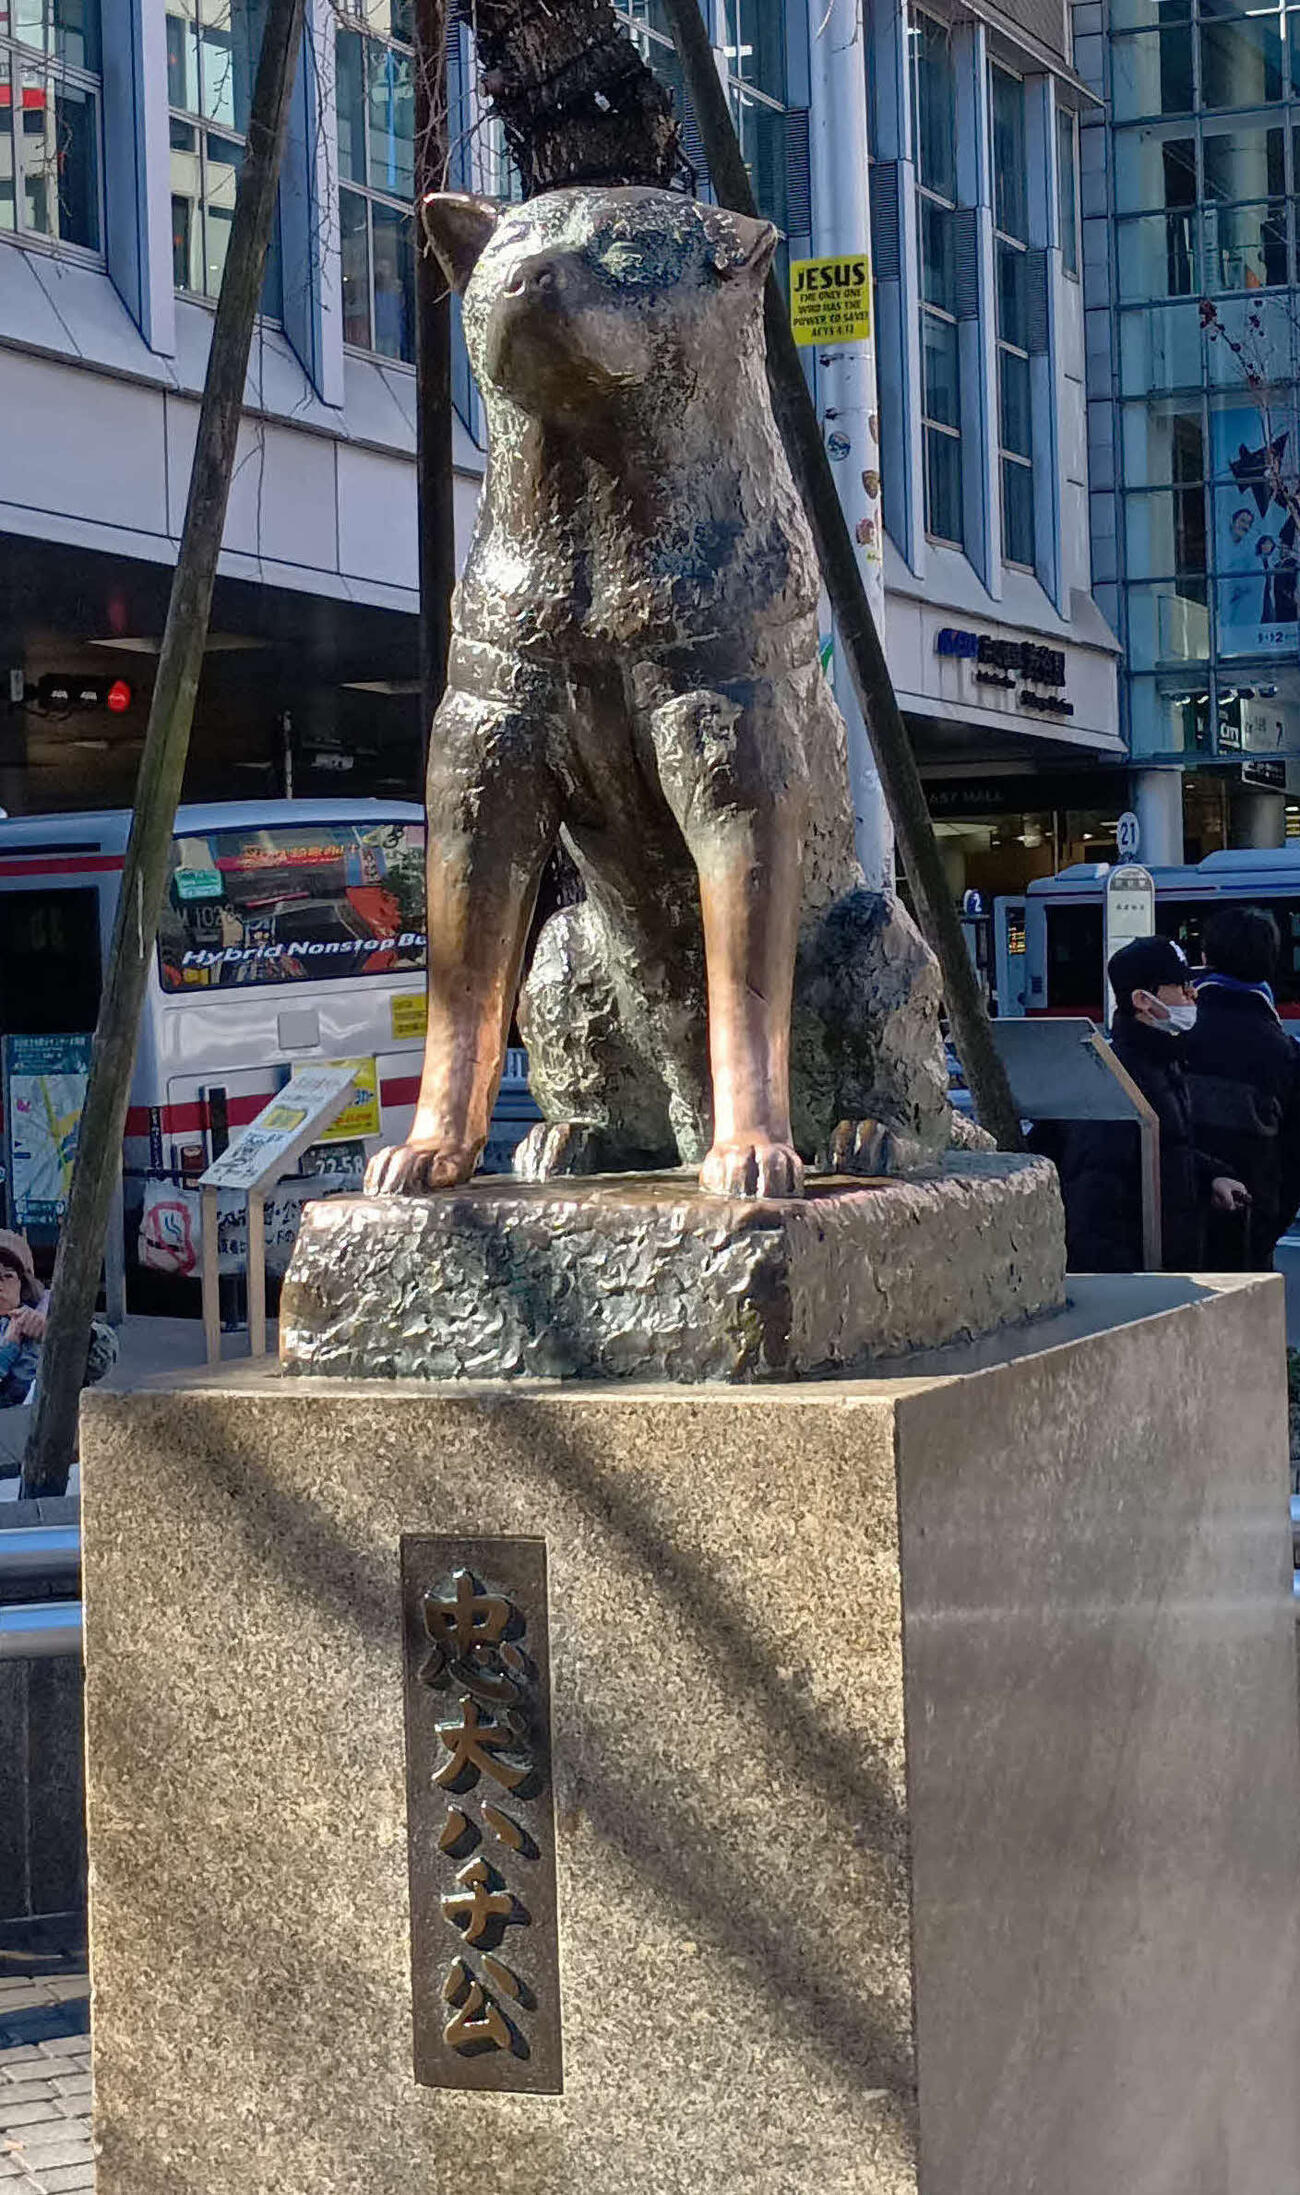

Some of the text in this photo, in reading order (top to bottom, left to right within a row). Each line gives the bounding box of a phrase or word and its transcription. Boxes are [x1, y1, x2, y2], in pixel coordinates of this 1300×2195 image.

[794, 262, 865, 292] JESUS
[1120, 823, 1136, 846] 21
[973, 892, 983, 912] 2
[181, 942, 281, 966] Hybrid
[286, 937, 396, 957] Nonstop
[418, 1568, 536, 2056] 忠犬ハチ公
